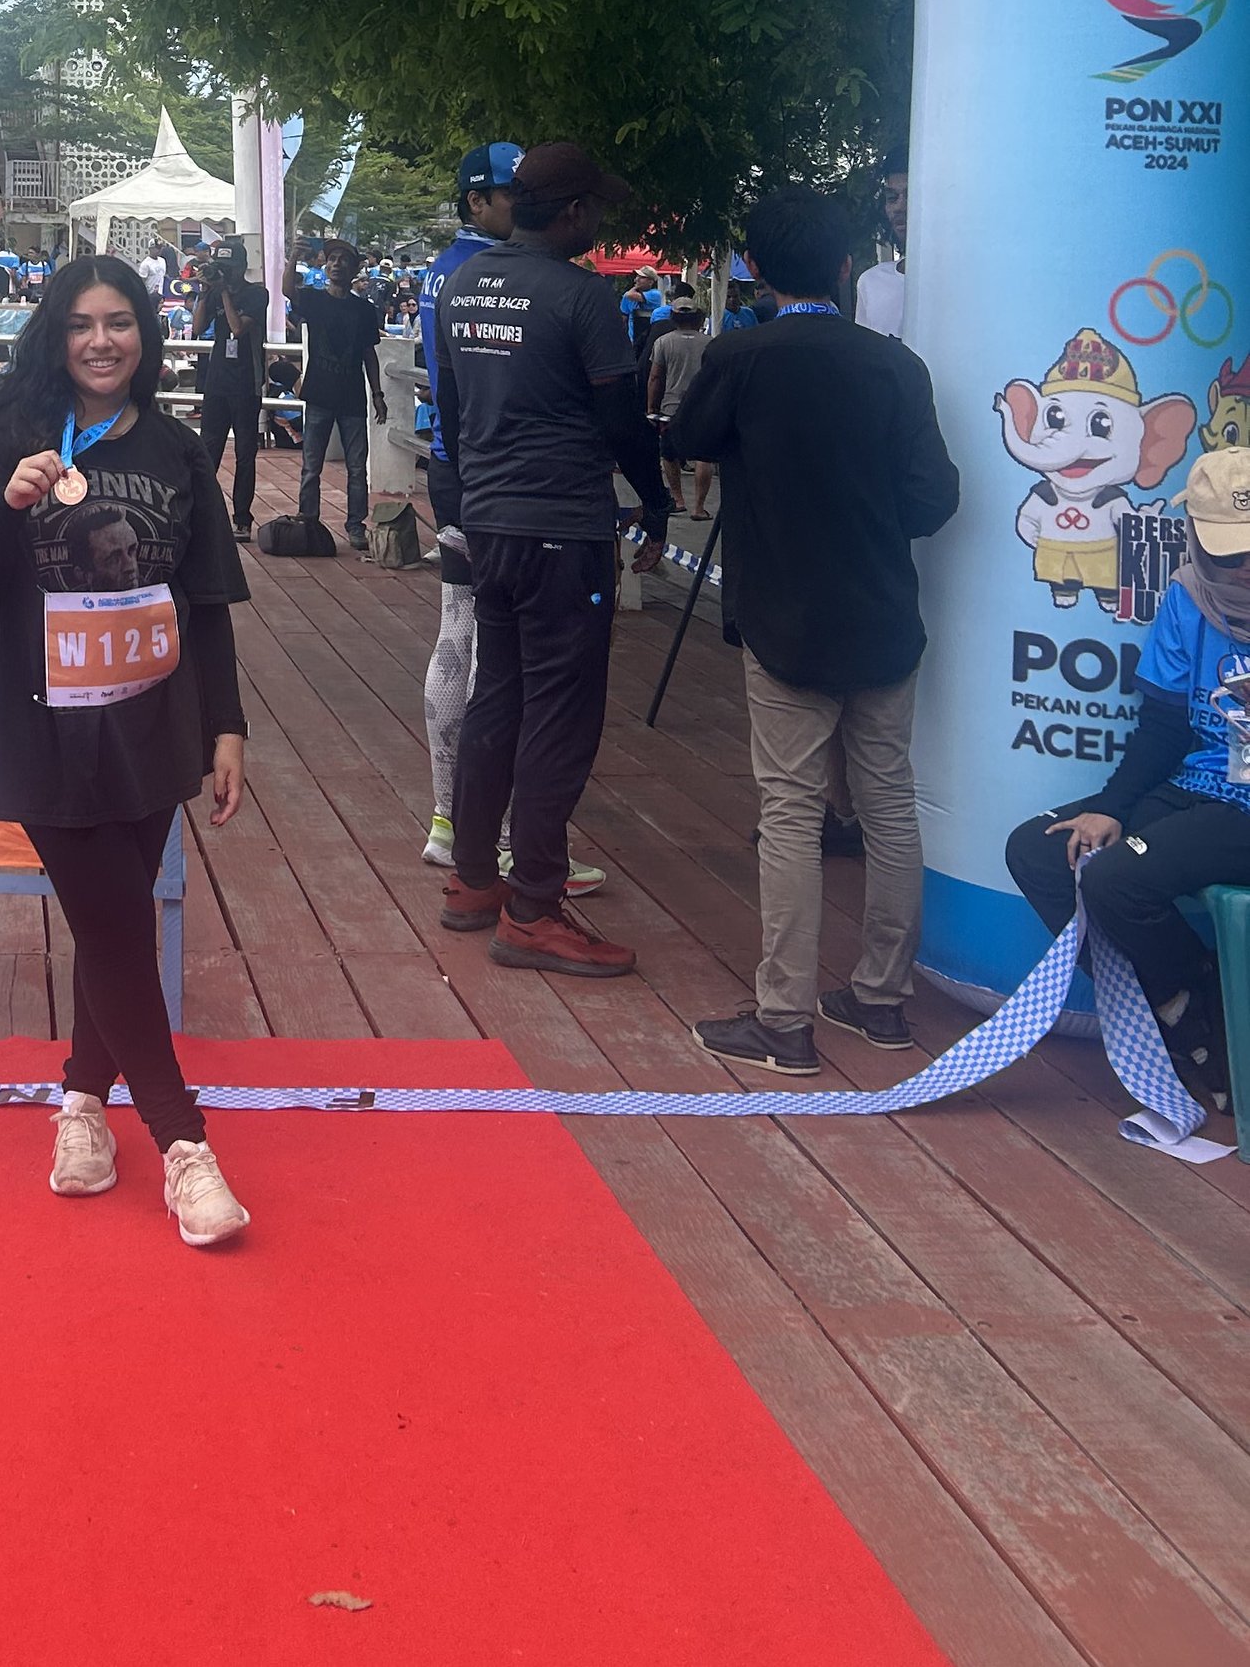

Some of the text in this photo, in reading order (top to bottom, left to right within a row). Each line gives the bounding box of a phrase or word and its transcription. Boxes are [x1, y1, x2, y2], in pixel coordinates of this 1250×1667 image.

[1105, 97, 1222, 125] PON XXI
[1105, 134, 1221, 153] ACEH-SUMUT
[1144, 154, 1189, 170] 2024
[491, 277, 506, 288] AN
[449, 296, 498, 308] ADVENTURE
[498, 297, 531, 311] RACER
[31, 469, 176, 517] JNNY
[1122, 513, 1187, 542] BERS
[1012, 691, 1081, 716] PEKAN
